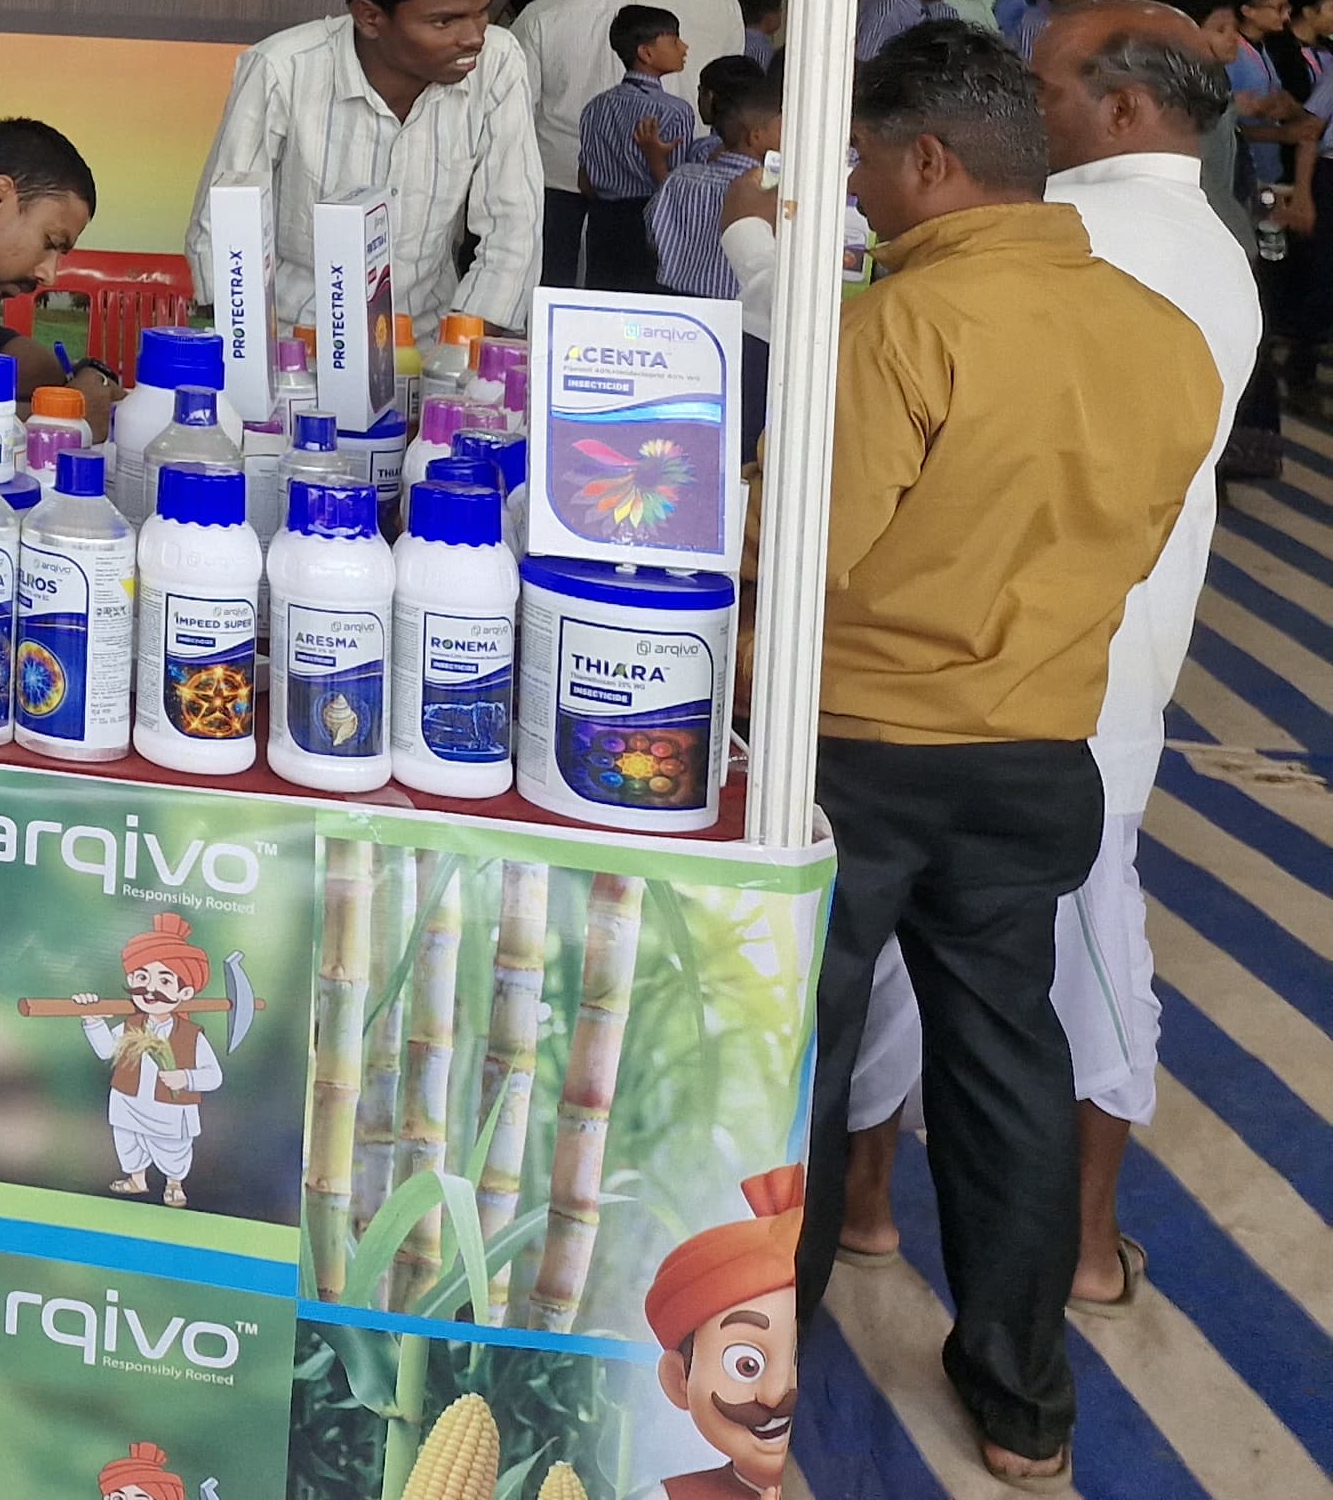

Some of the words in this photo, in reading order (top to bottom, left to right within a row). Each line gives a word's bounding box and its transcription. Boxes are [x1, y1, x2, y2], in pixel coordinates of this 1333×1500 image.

[232, 250, 247, 360] PROTECTRA-X
[333, 265, 347, 370] PROTECTRA-X
[643, 326, 698, 342] arqivo
[564, 344, 669, 370] ACENTA
[567, 379, 630, 392] INSECTICIDE
[175, 611, 221, 629] IMPEED
[224, 617, 253, 629] SUPER
[295, 631, 358, 649] ARESMA
[430, 637, 499, 652] RONEMA
[654, 643, 700, 658] arqivo
[571, 653, 666, 683] THIARA
[572, 685, 630, 704] INSECTICIDE
[122, 884, 203, 908] Responsibly
[206, 896, 255, 916] Rooted
[102, 1356, 183, 1379] Responsibly
[185, 1368, 234, 1386] Rooted
